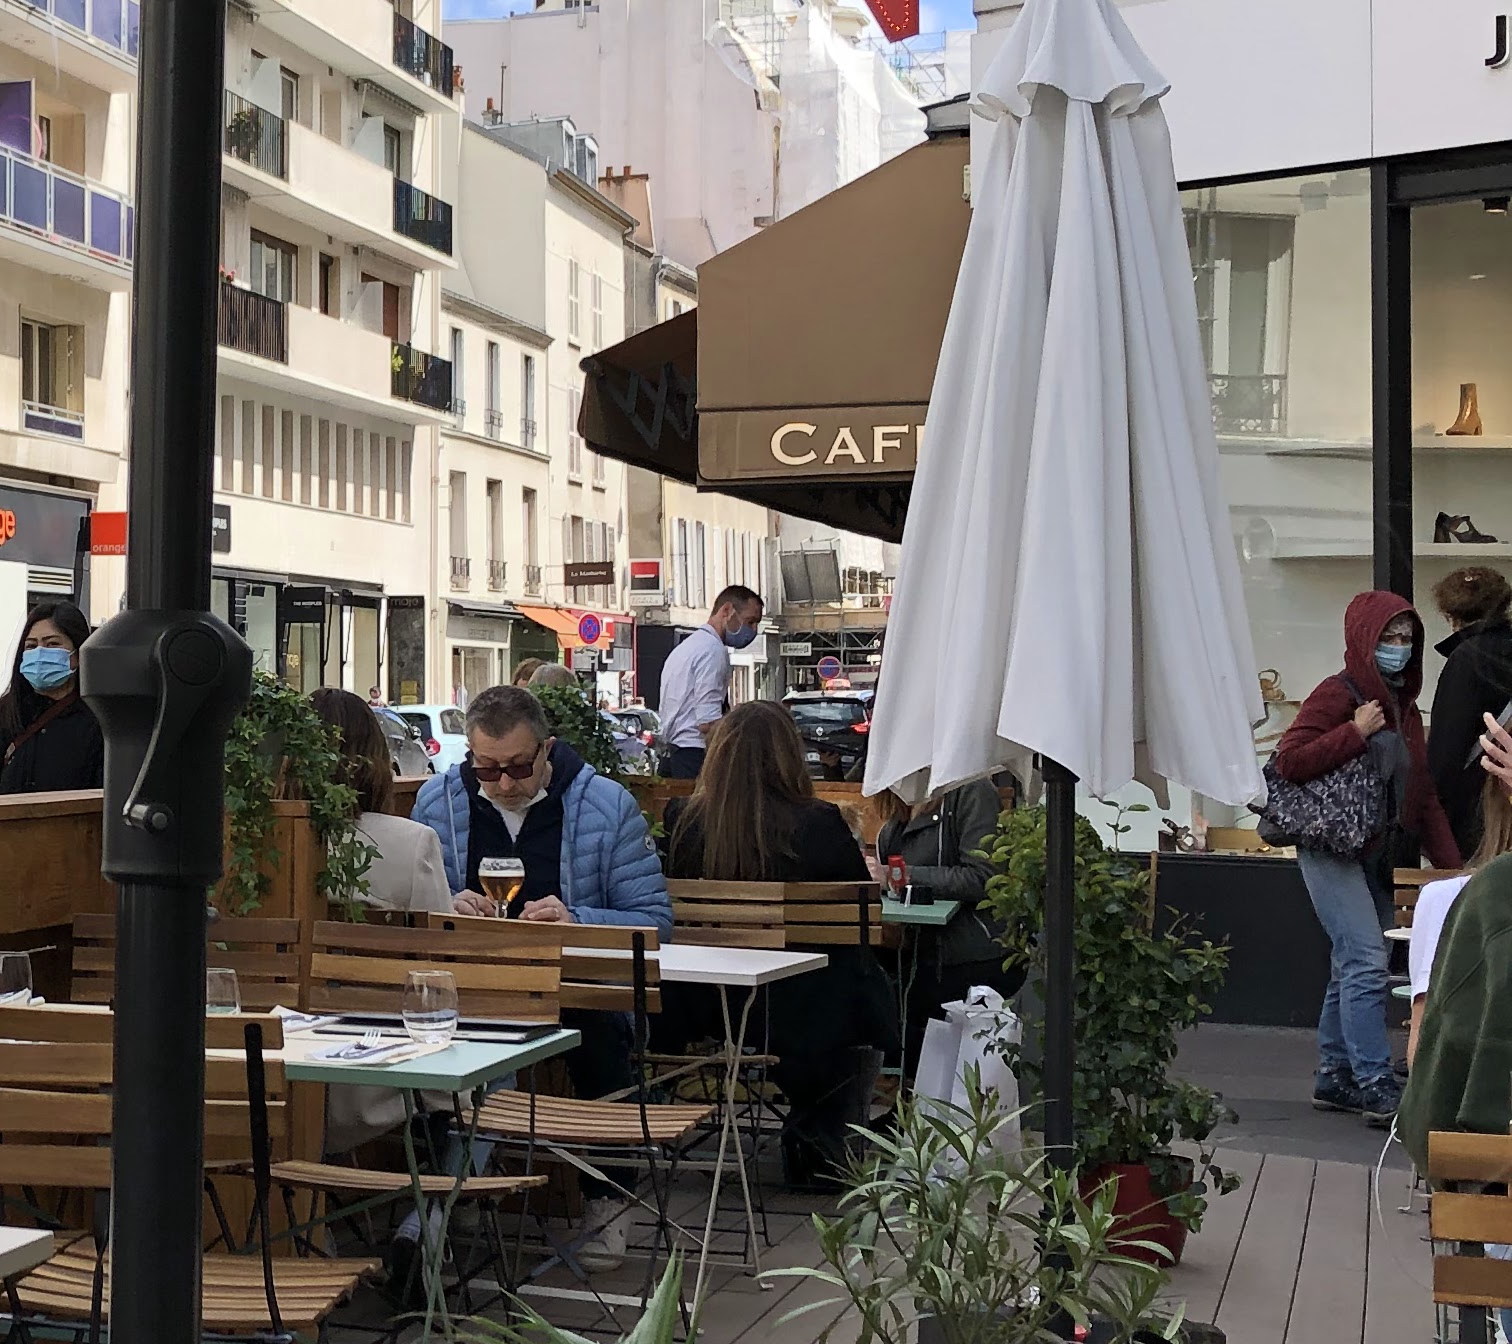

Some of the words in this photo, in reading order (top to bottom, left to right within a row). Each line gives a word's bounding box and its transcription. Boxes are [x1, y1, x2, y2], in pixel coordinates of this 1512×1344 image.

[1484, 14, 1507, 67] J
[769, 421, 924, 467] CAF
[92, 544, 127, 554] orange
